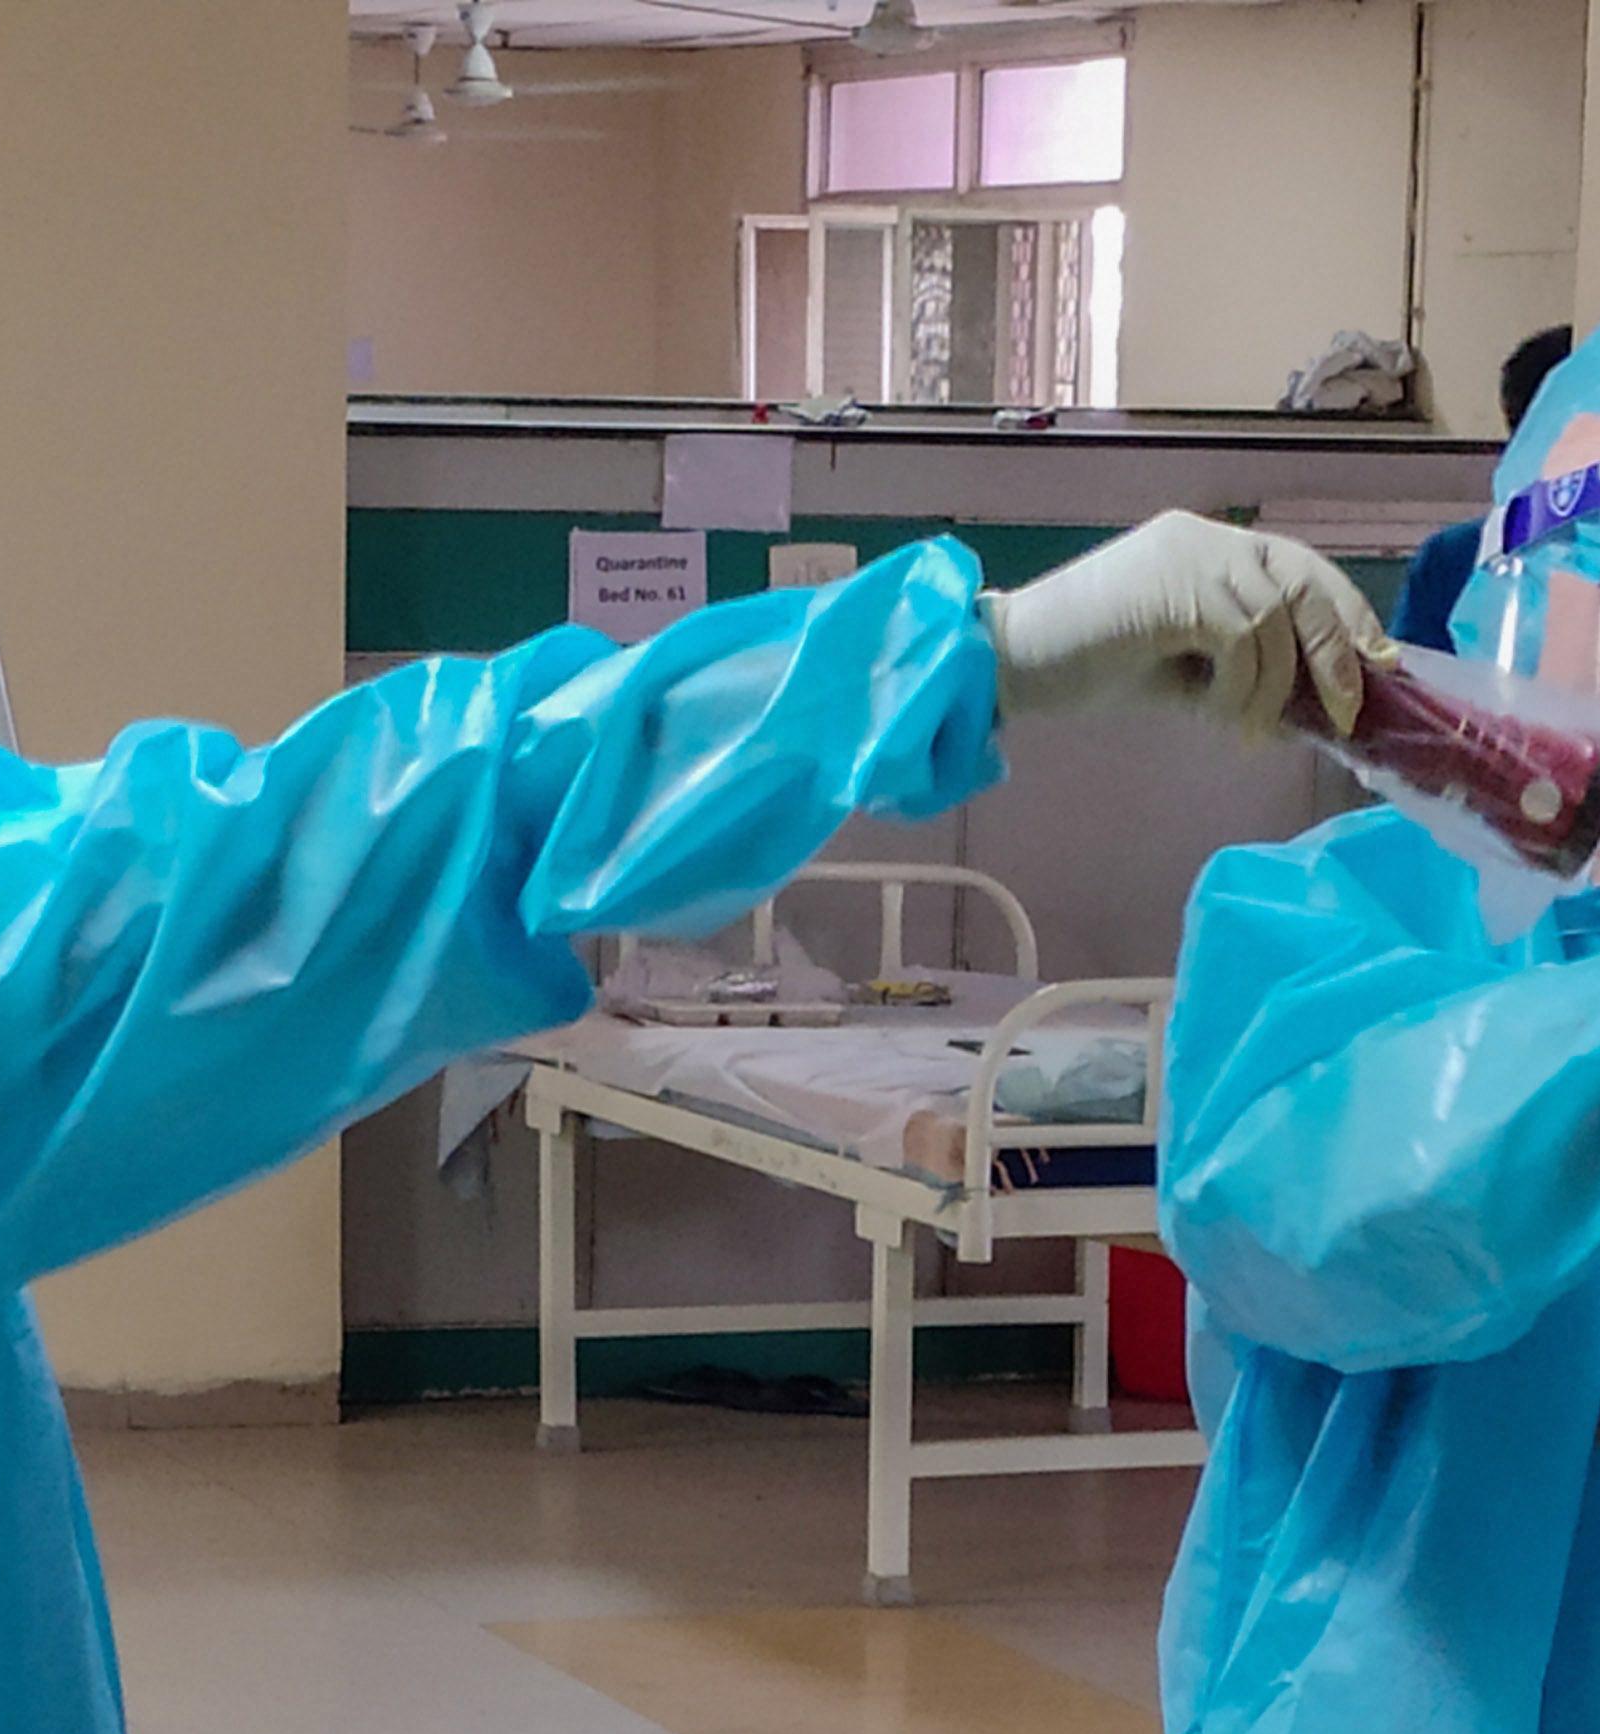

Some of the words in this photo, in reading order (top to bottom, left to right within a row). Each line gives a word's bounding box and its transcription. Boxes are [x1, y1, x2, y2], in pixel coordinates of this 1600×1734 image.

[596, 556, 687, 572] Quarantine
[598, 586, 630, 602] Bed
[634, 587, 661, 602] No.
[667, 585, 686, 601] 61
